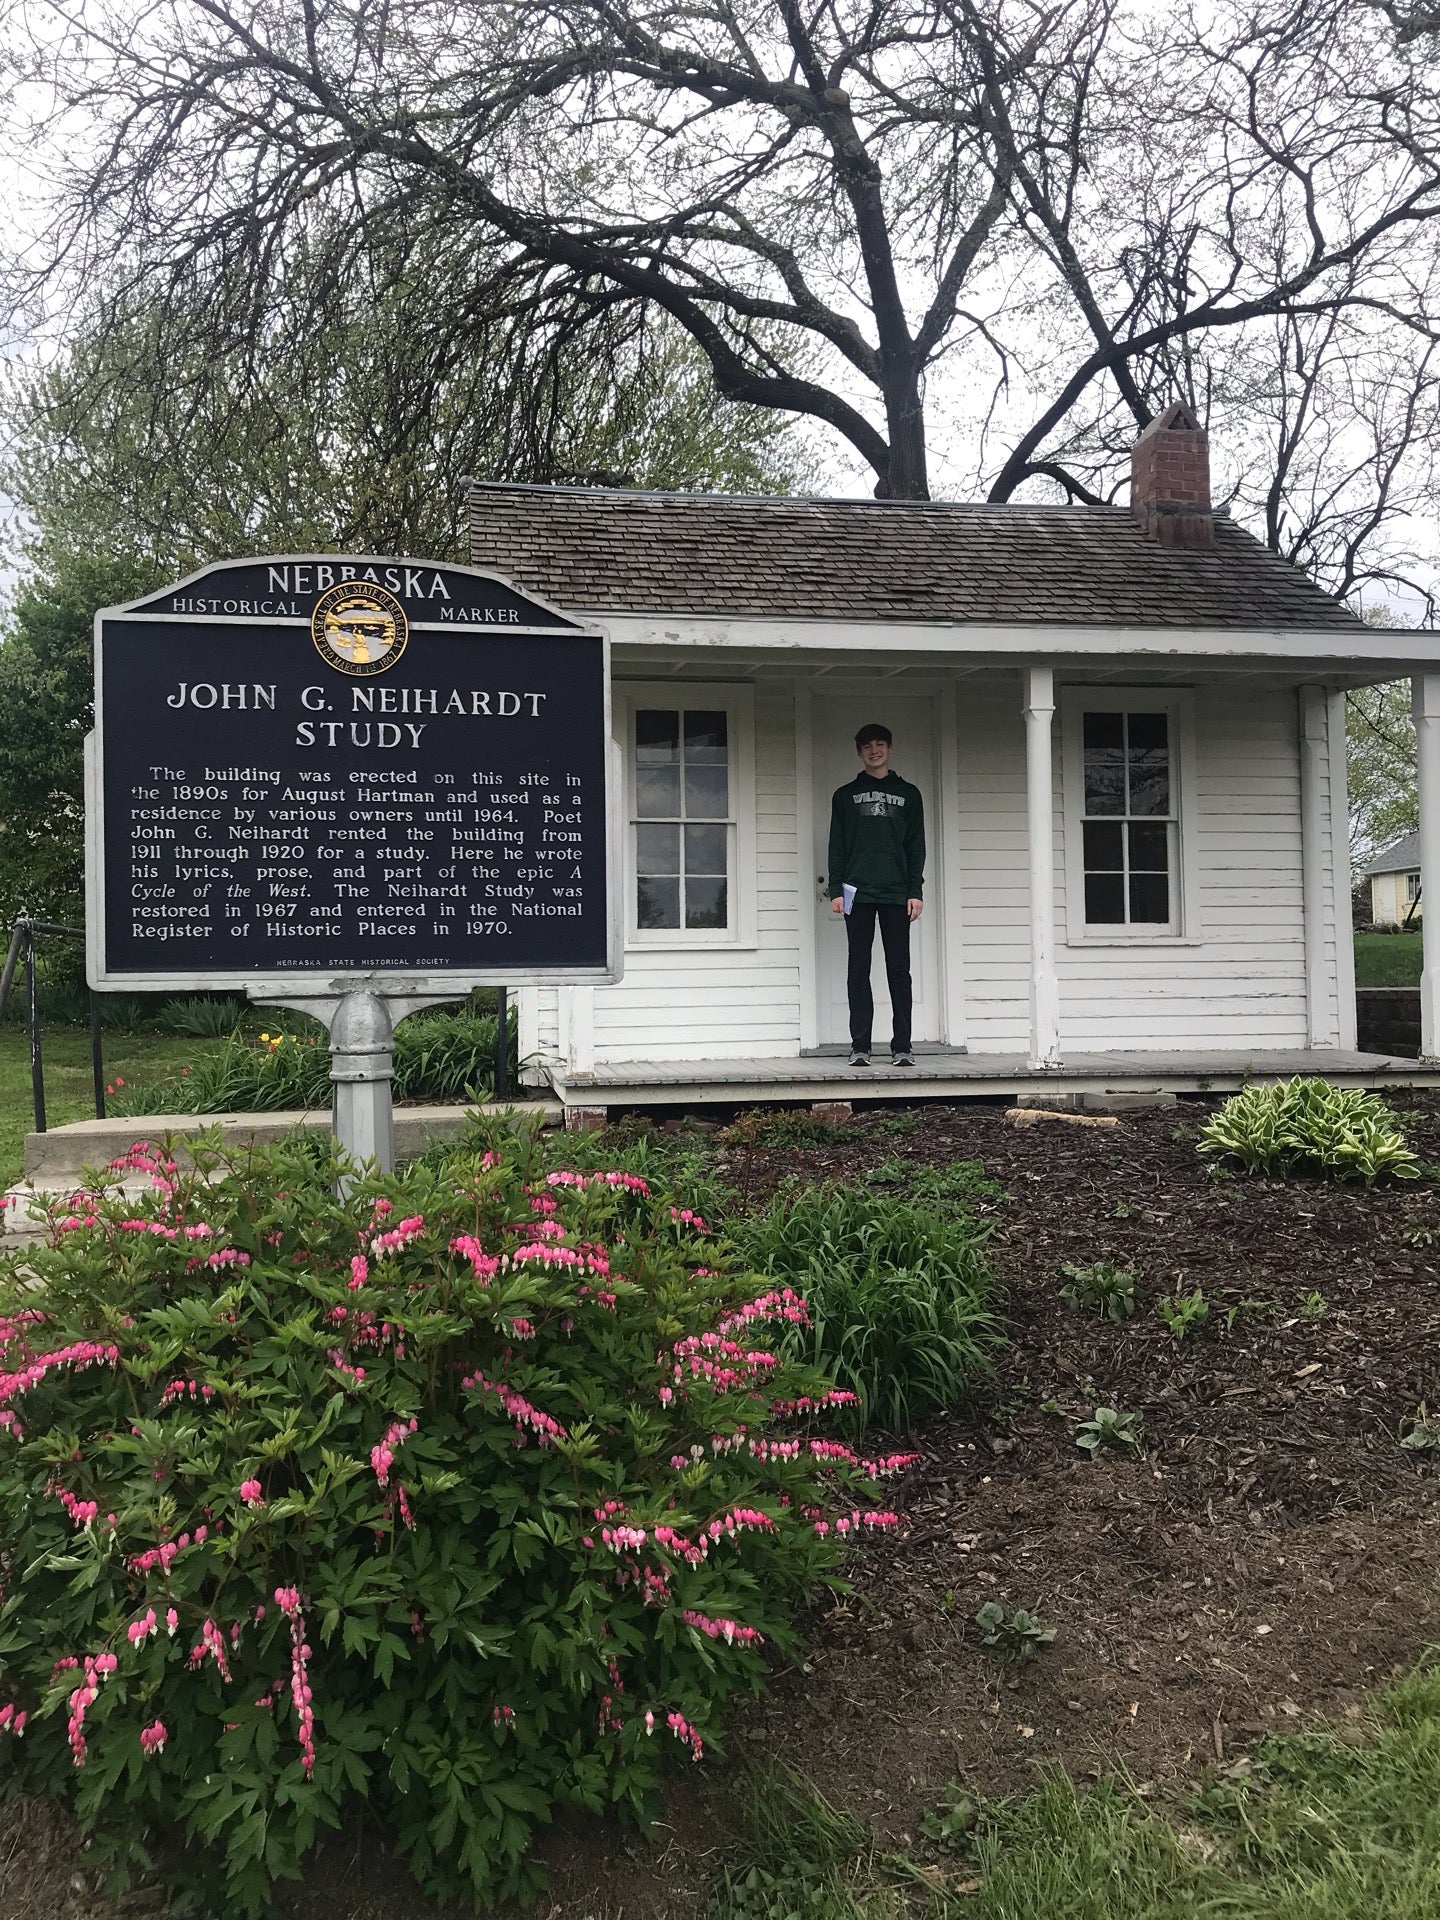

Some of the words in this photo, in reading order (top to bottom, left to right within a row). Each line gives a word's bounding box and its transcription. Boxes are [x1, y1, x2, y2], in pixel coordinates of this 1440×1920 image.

[268, 565, 451, 600] NEBRASKA
[174, 599, 300, 614] HISTORICAL
[440, 607, 519, 622] MARKER
[315, 609, 327, 631] SEAL
[333, 587, 351, 600] THE
[352, 585, 378, 597] STATE
[379, 593, 391, 604] OF
[389, 602, 405, 648] NEBRASKA
[332, 659, 362, 673] MARCH
[379, 651, 397, 668] 1867
[167, 683, 277, 709] JOHN
[302, 687, 332, 710] G.
[352, 688, 546, 716] NEIHARDT
[296, 722, 426, 748] STUDY
[150, 767, 185, 780] The
[205, 768, 280, 785] building
[299, 772, 330, 781] was
[349, 771, 417, 783] erected
[435, 774, 454, 783] on
[472, 772, 502, 784] this
[519, 773, 549, 785] site
[567, 773, 580, 786] in
[132, 787, 159, 799] the
[173, 786, 227, 799] 1890s
[242, 787, 268, 800] for
[282, 787, 345, 804] August
[358, 789, 434, 802] Hartman
[447, 791, 477, 803] and
[490, 792, 528, 804] used
[543, 795, 559, 804] as
[572, 796, 581, 804] a
[131, 806, 221, 819] residence
[234, 807, 255, 822] by
[269, 807, 336, 820] various
[350, 811, 412, 821] owners
[425, 809, 462, 821] until
[475, 809, 518, 822] 1964.
[544, 810, 581, 823] Poet
[131, 826, 175, 838] John
[195, 826, 212, 839] G.
[229, 826, 309, 839] Neihardt
[329, 828, 386, 840] rented
[407, 828, 433, 840] the
[453, 828, 524, 844] building
[543, 829, 582, 841] from
[132, 845, 160, 858] 1911
[174, 846, 249, 862] through
[262, 845, 304, 858] 1920
[317, 846, 343, 858] for
[355, 849, 364, 859] a
[377, 847, 429, 861] study.
[451, 847, 493, 859] Here
[504, 848, 523, 859] he
[535, 848, 582, 860] wrote
[132, 865, 158, 877] his
[176, 865, 233, 880] lyrics,
[257, 868, 312, 880] prose,
[333, 866, 365, 877] and
[384, 866, 421, 881] part
[439, 866, 456, 878] of
[472, 866, 499, 878] the
[517, 866, 553, 881] epic
[570, 865, 581, 878] A
[132, 884, 175, 900] Cycle
[194, 884, 212, 897] of
[227, 884, 250, 897] the
[269, 884, 310, 897] West.
[334, 884, 369, 897] The
[388, 884, 466, 897] Neihardt
[485, 885, 534, 899] Study
[552, 888, 582, 897] was
[132, 905, 209, 917] restored
[225, 904, 240, 917] in
[256, 903, 297, 916] 1967
[310, 904, 342, 916] and
[357, 904, 425, 916] entered
[440, 903, 455, 915] in
[470, 904, 497, 915] the
[512, 903, 582, 915] National
[133, 924, 212, 941] Register
[231, 924, 249, 936] of
[267, 923, 341, 936] Historic
[359, 922, 416, 935] Places
[433, 922, 448, 934] in
[467, 921, 512, 934] 1970.
[276, 959, 321, 967] NEBRASKA
[361, 958, 410, 966] HISTORICAL
[415, 957, 450, 965] SOCIETY
